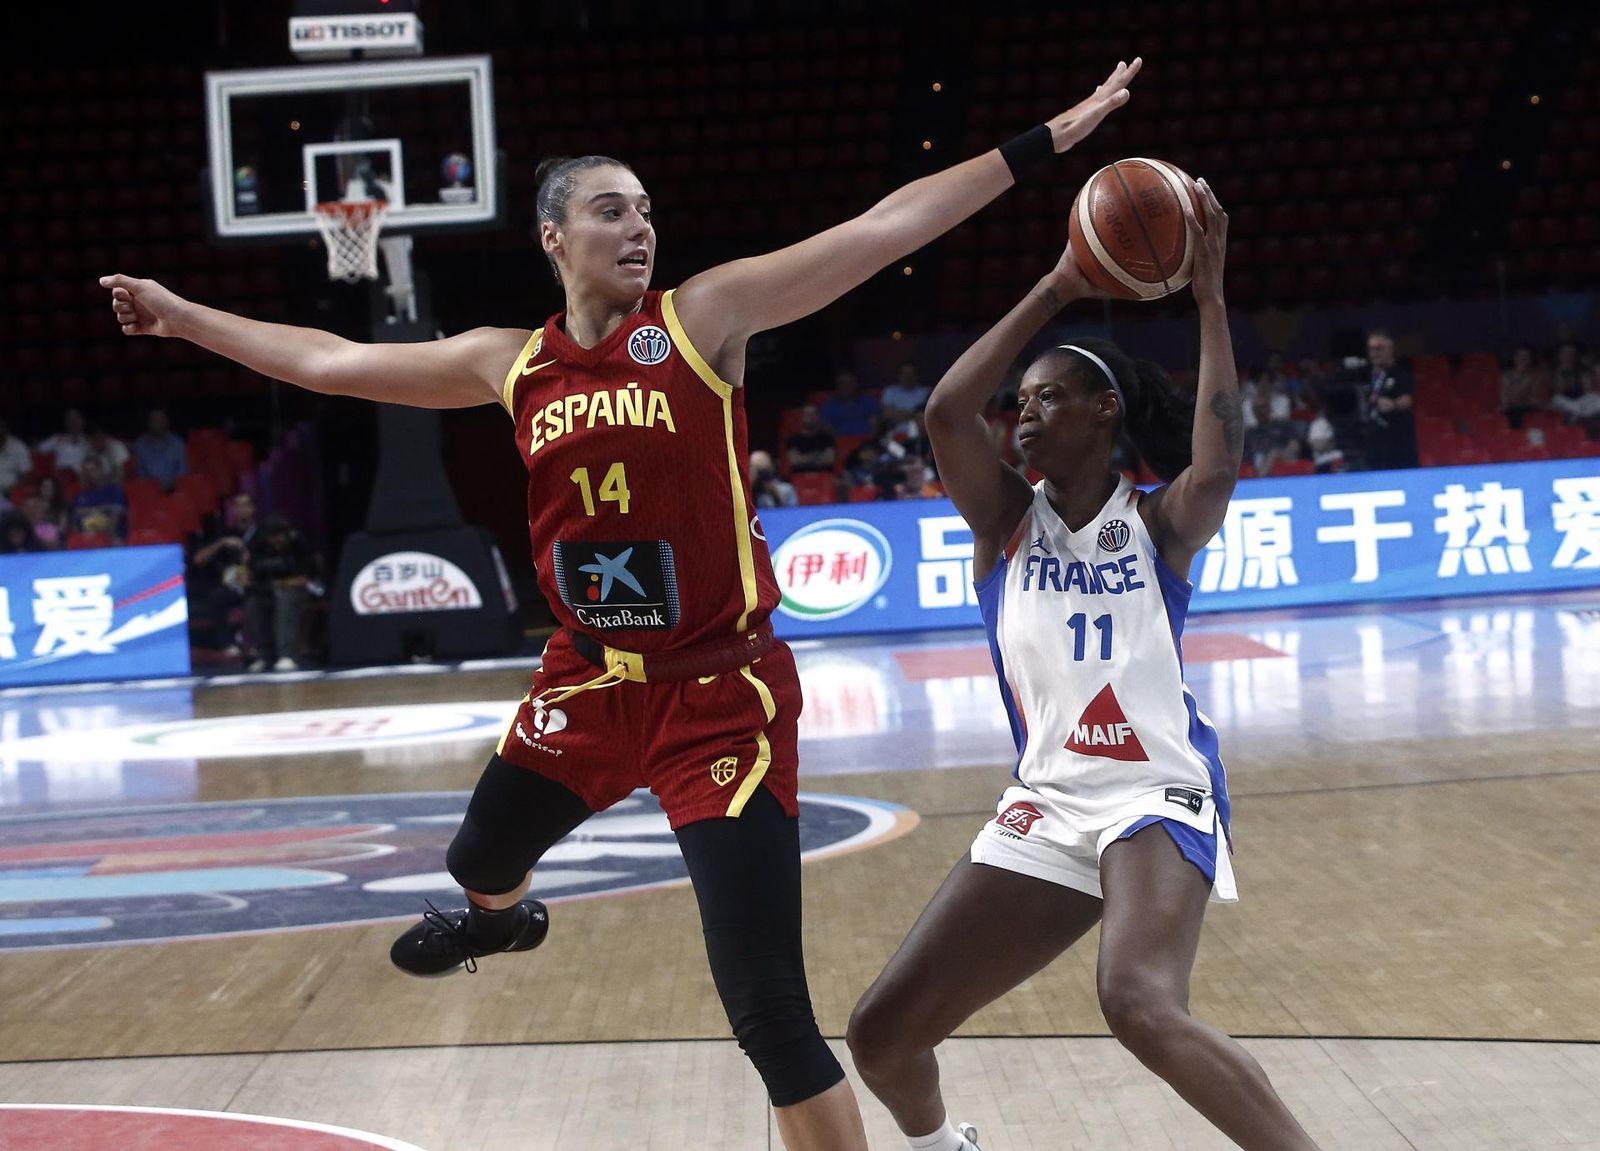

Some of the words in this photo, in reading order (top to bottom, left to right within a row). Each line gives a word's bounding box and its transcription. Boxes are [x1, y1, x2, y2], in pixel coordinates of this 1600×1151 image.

[329, 22, 406, 38] TISSOT
[530, 382, 677, 456] ESPAÑA
[569, 462, 631, 517] 14
[787, 551, 868, 587] 伊利
[1023, 554, 1145, 595] FRANCE
[1066, 613, 1113, 661] 11
[1073, 722, 1133, 746] MAIF
